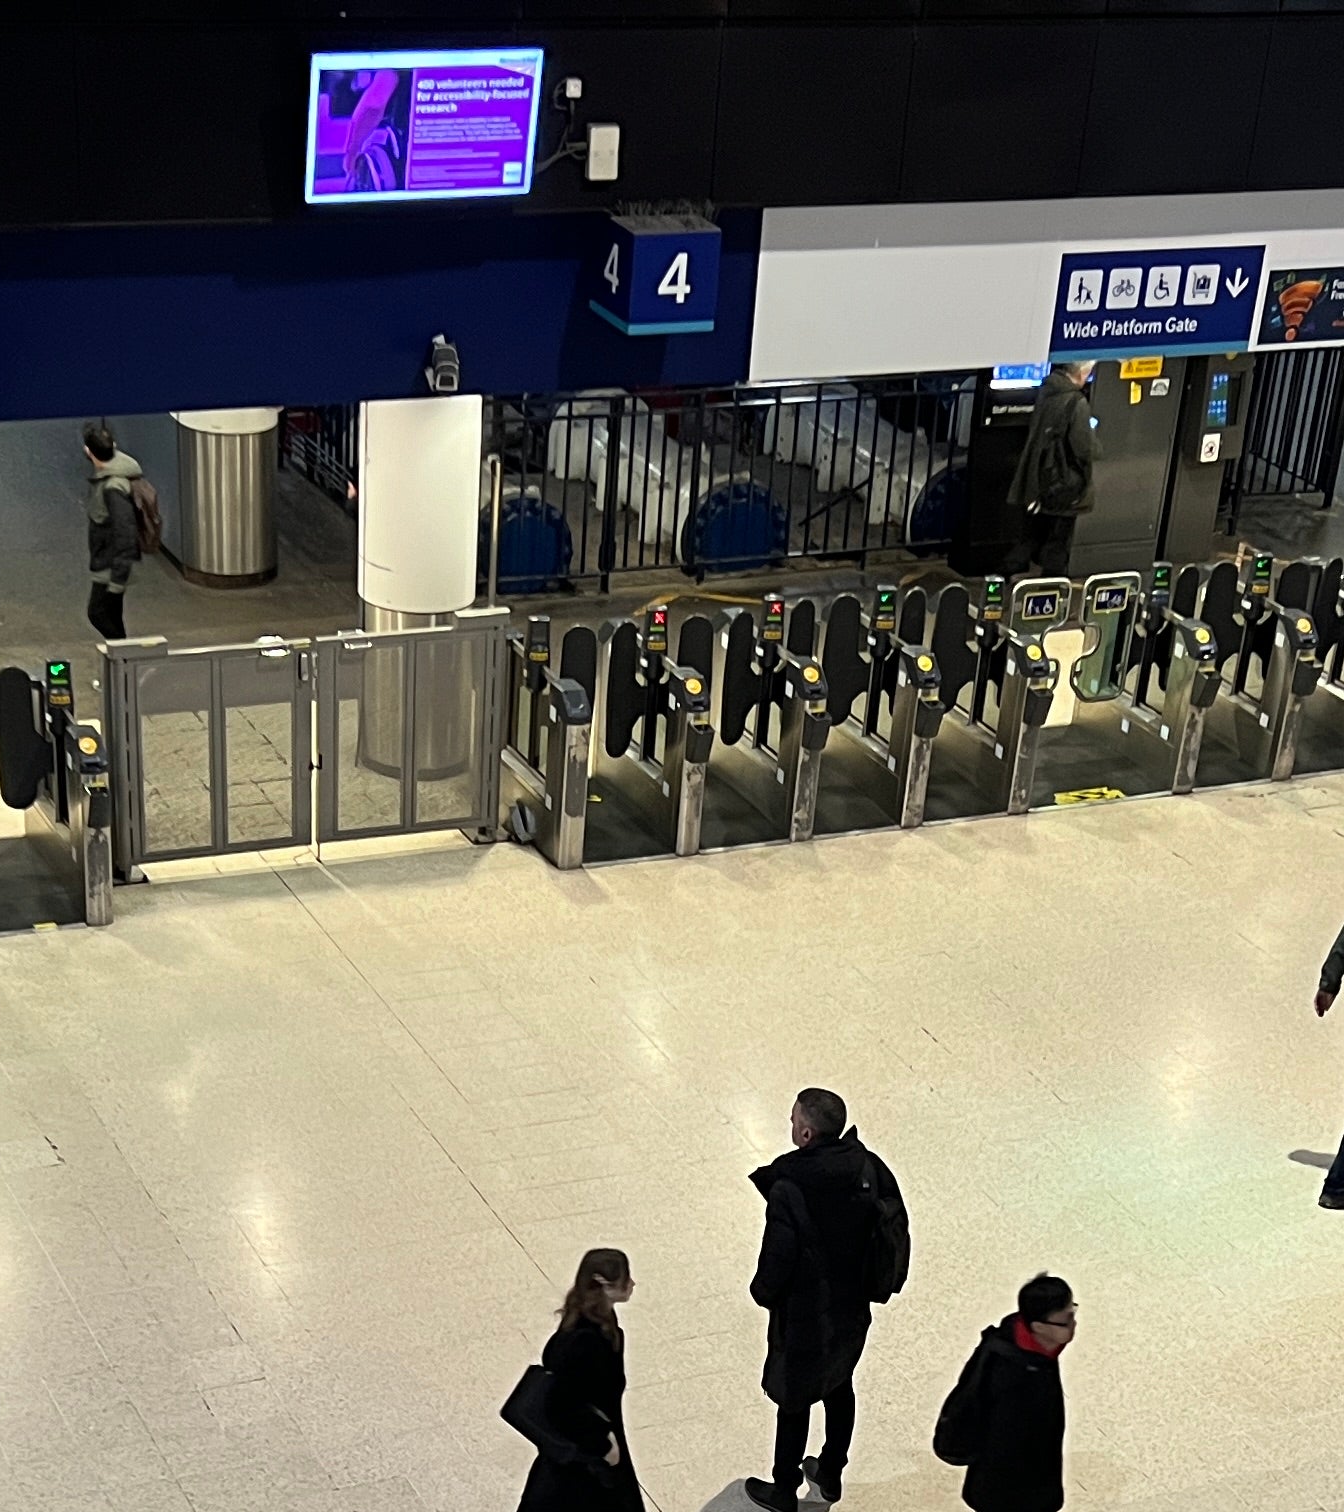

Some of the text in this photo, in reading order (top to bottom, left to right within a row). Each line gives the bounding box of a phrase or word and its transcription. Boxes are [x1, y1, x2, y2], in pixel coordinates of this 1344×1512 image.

[603, 242, 619, 294] 4
[658, 252, 691, 304] 4
[1063, 316, 1198, 339] Wide Platform Gate
